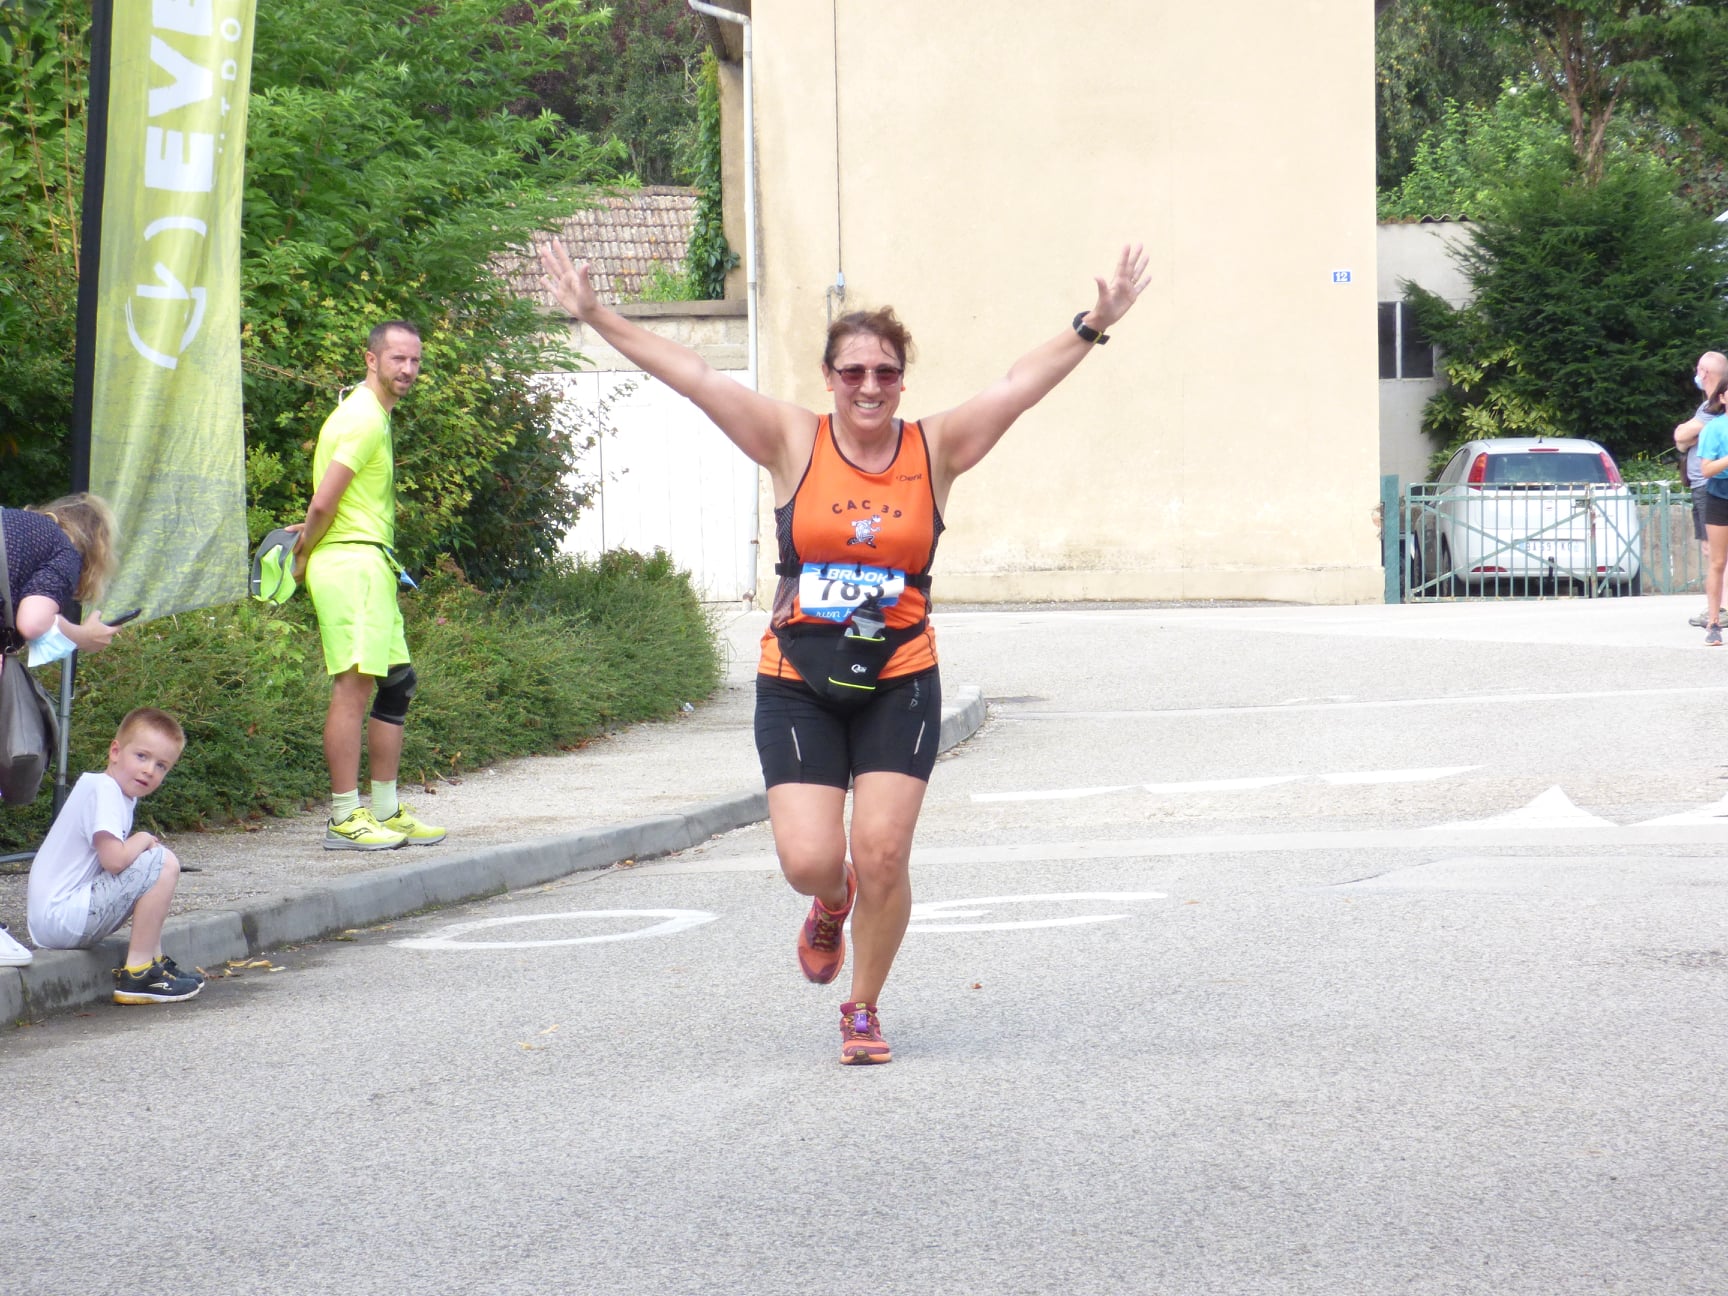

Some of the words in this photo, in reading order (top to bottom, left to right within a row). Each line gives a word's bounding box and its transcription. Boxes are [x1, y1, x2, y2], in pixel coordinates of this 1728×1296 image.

[1335, 271, 1348, 282] 12
[832, 499, 871, 515] CAC
[881, 504, 902, 519] 39
